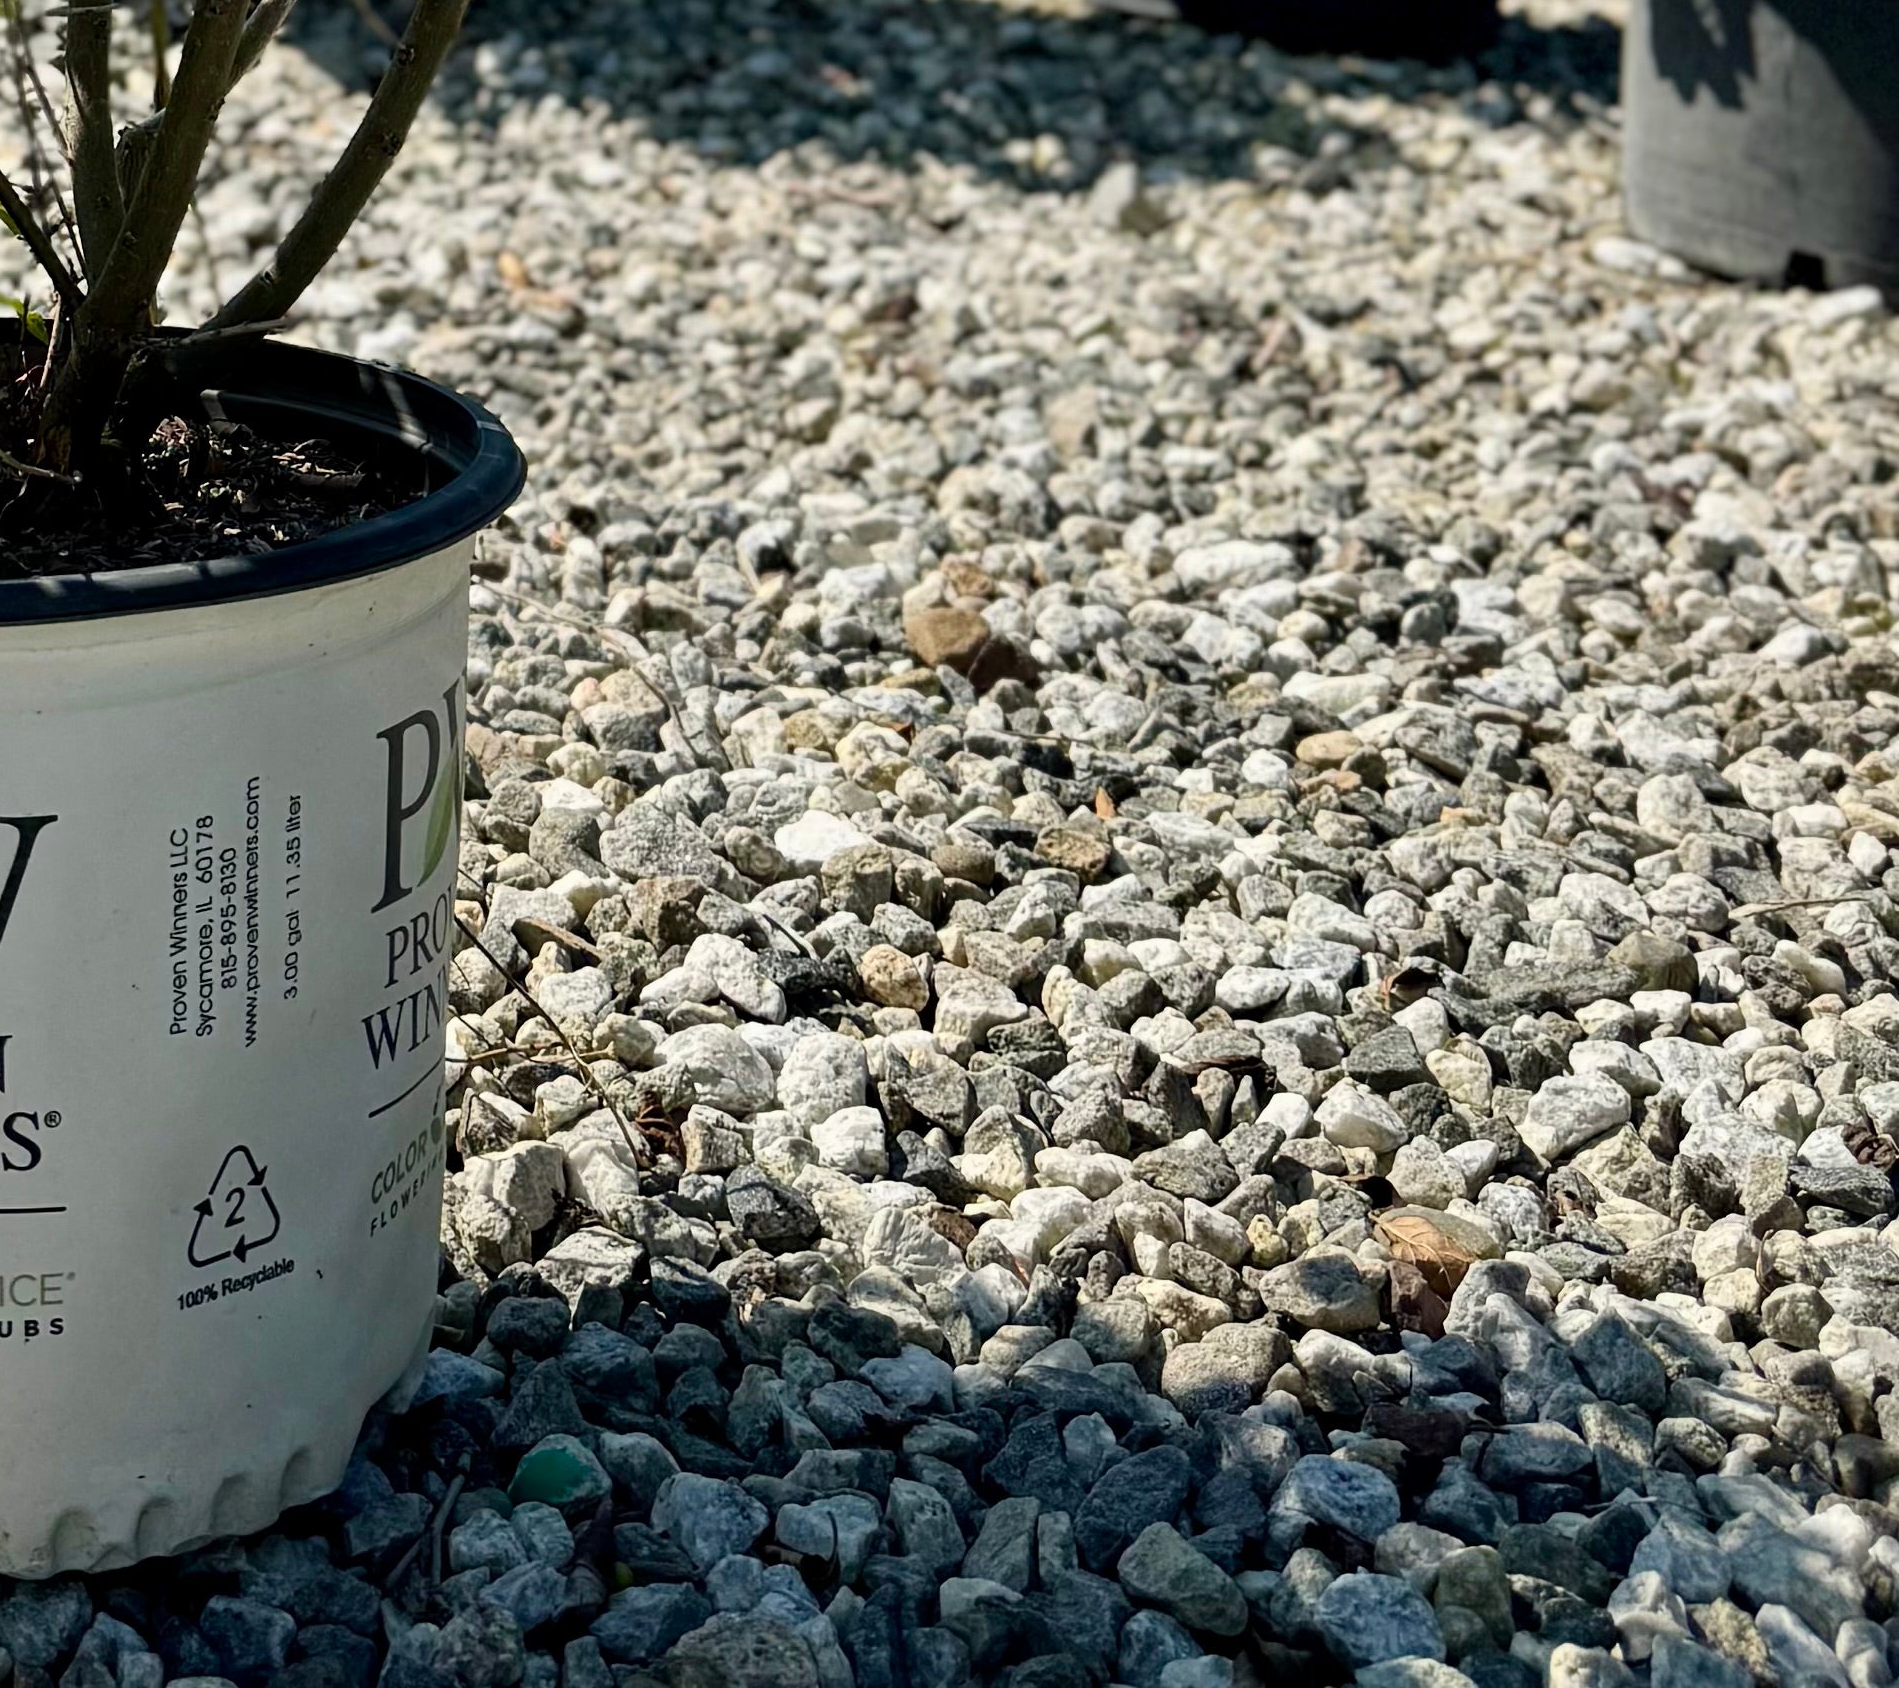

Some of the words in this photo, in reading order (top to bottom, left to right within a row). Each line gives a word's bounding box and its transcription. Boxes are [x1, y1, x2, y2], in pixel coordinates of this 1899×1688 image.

[285, 794, 302, 833] liter
[371, 678, 461, 914] P
[169, 827, 189, 868] LLC
[195, 815, 214, 884] 60178
[169, 872, 188, 957] Winners
[195, 895, 213, 913] IL
[219, 847, 238, 989] 815-895-8130
[244, 776, 261, 1048] www.provenwinners.com
[285, 910, 302, 946] gal
[384, 887, 452, 989] PRO
[169, 960, 188, 1035] Proven
[195, 918, 217, 1037] Sycamore,
[283, 951, 299, 1000] 3.00
[361, 963, 450, 1069] WIN
[371, 1129, 428, 1204] COLOR
[224, 1187, 246, 1228] 2
[177, 1282, 219, 1311] 100%
[221, 1258, 295, 1297] Recyclable
